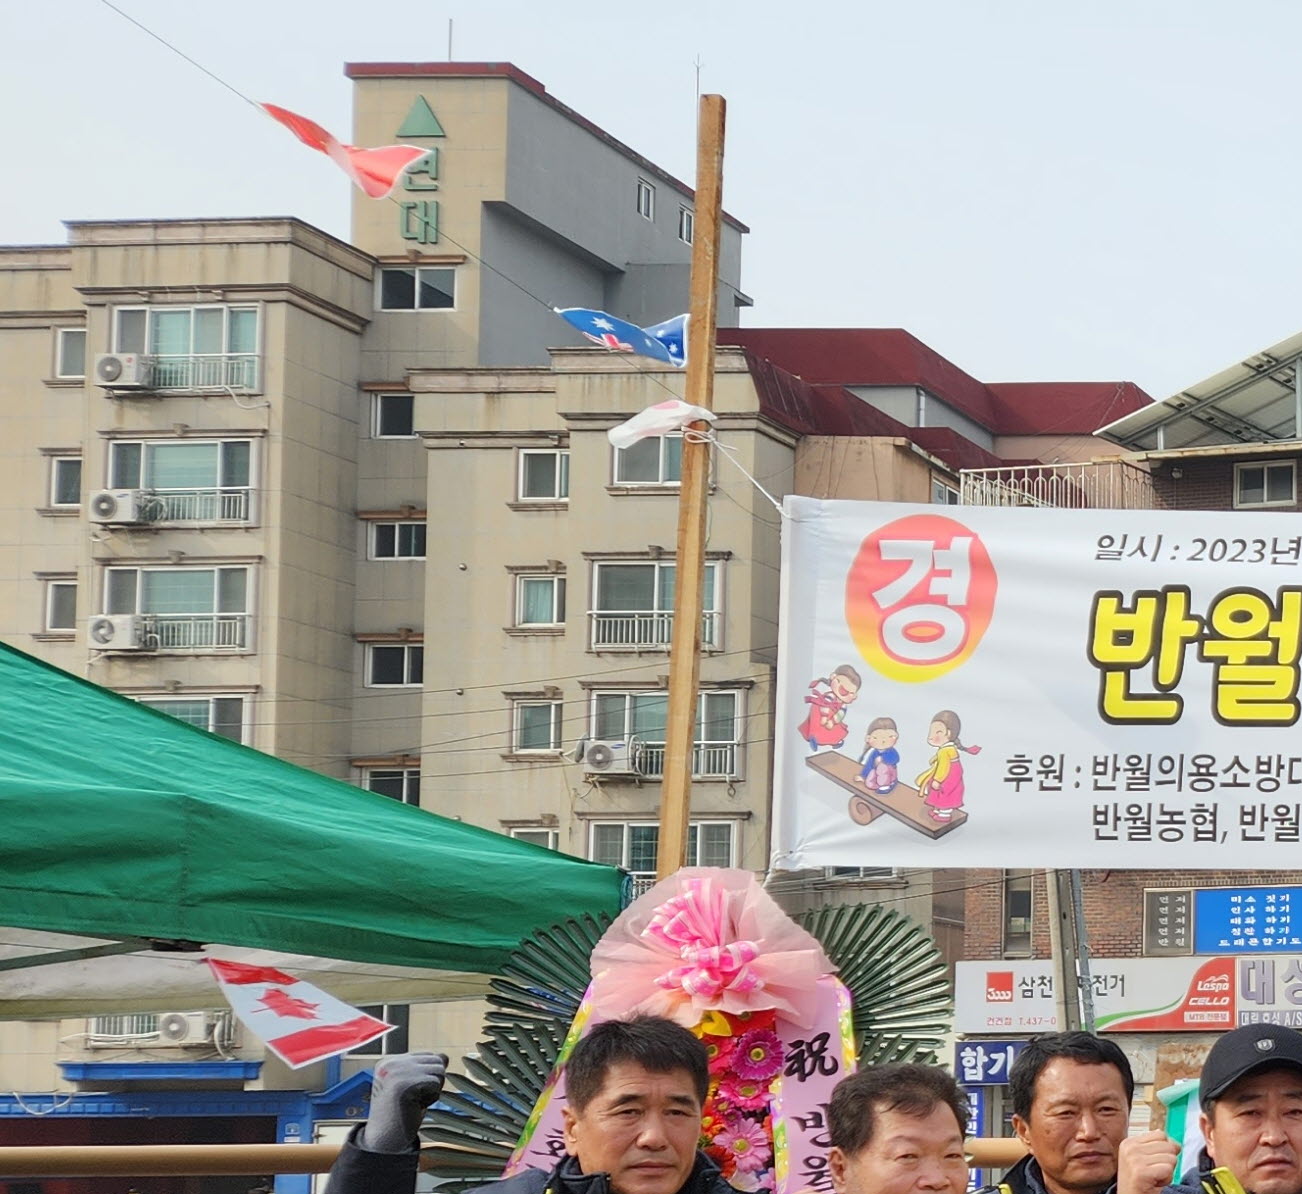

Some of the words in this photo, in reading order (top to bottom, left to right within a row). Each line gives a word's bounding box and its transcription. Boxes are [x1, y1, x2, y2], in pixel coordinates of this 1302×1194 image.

[1095, 534, 1162, 562] 일시
[1191, 536, 1302, 565] 2023년
[870, 534, 977, 665] 경
[1004, 754, 1064, 792] 후원
[1093, 803, 1227, 844] 반월농협,
[1018, 975, 1125, 998] 삼천전거
[1189, 997, 1229, 1006] CELLO
[1285, 1011, 1302, 1025] A/S
[784, 1032, 838, 1082] 祝
[960, 1046, 1014, 1081] 합기
